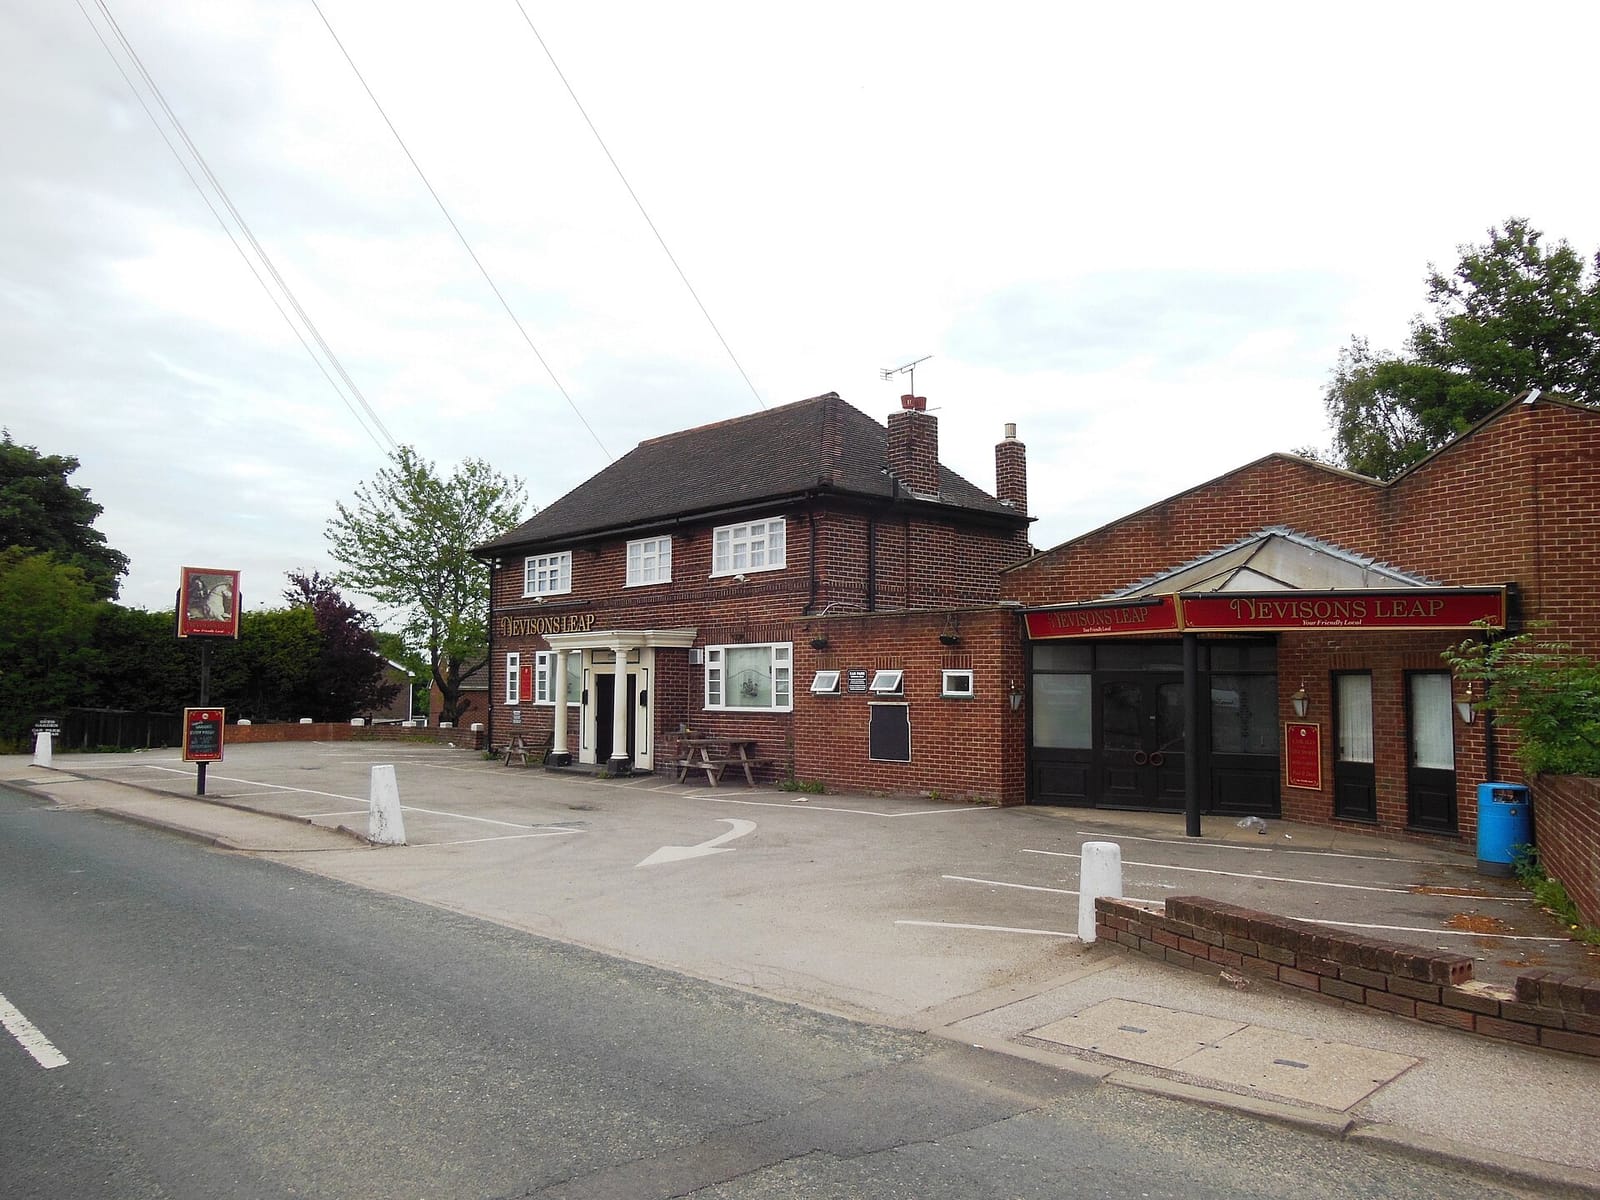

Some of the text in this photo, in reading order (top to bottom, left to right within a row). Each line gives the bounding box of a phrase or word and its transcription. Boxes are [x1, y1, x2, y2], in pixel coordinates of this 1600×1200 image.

[1047, 606, 1149, 629] NEVISONS LEAP
[1230, 598, 1444, 619] NEVISONS LEAP
[501, 614, 595, 636] NEVISONS LEAP
[1302, 619, 1317, 627] Your
[1317, 619, 1343, 627] Friendly
